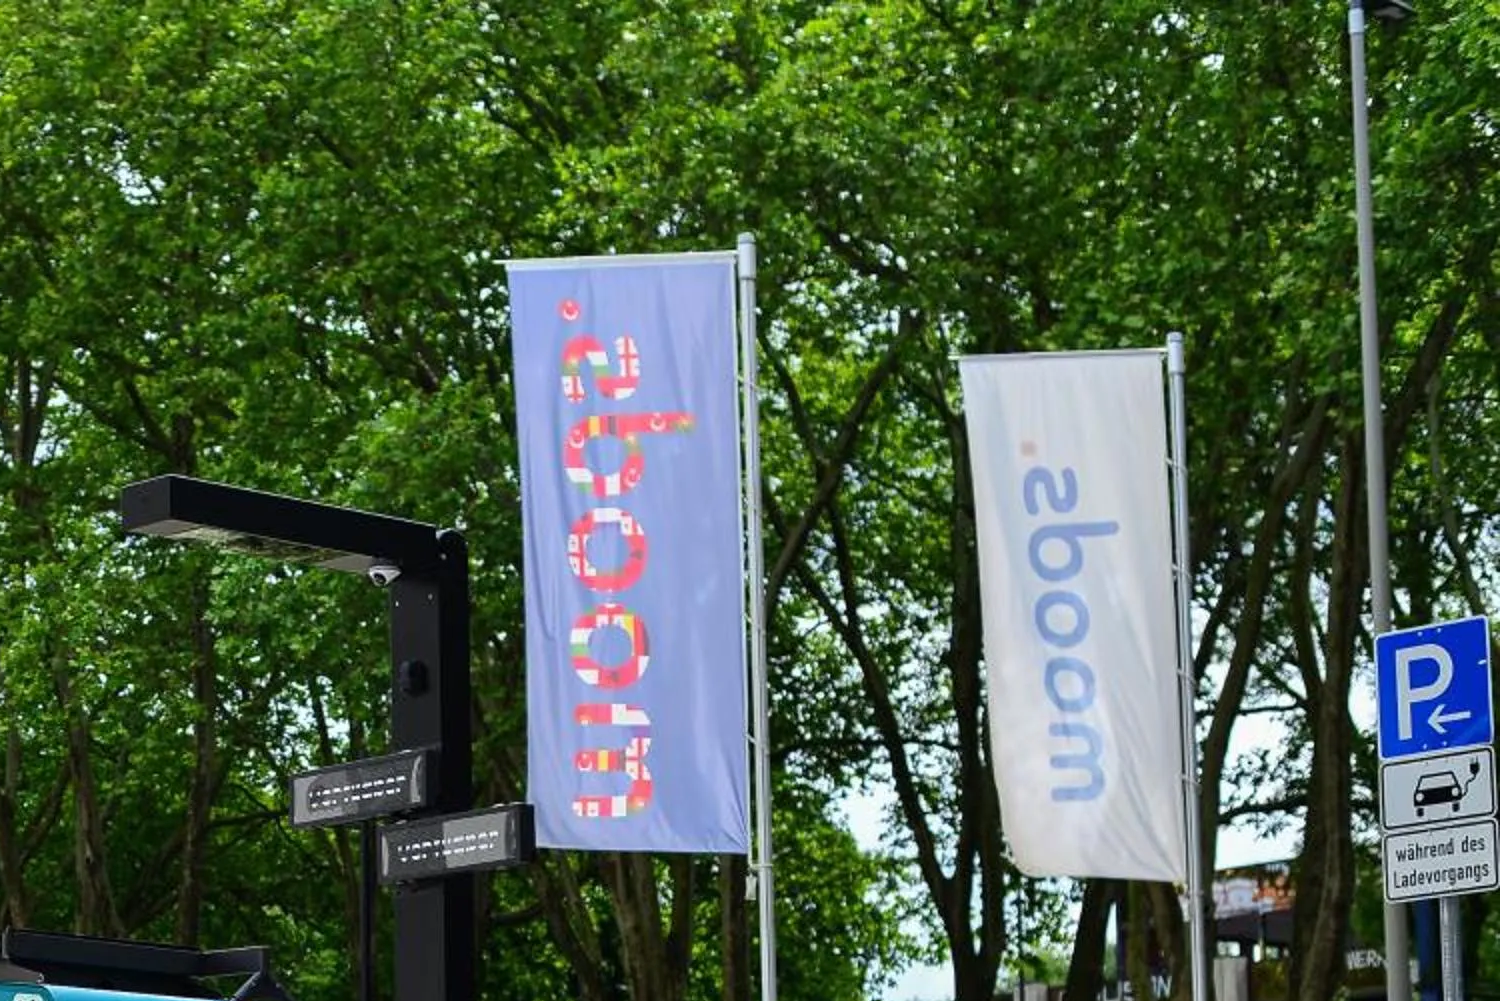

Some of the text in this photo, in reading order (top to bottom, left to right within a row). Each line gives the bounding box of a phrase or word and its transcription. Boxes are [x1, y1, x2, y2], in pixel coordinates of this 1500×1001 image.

[1395, 643, 1453, 741] P
[1395, 835, 1485, 862] während des
[1393, 863, 1489, 889] Ladevorgangs
